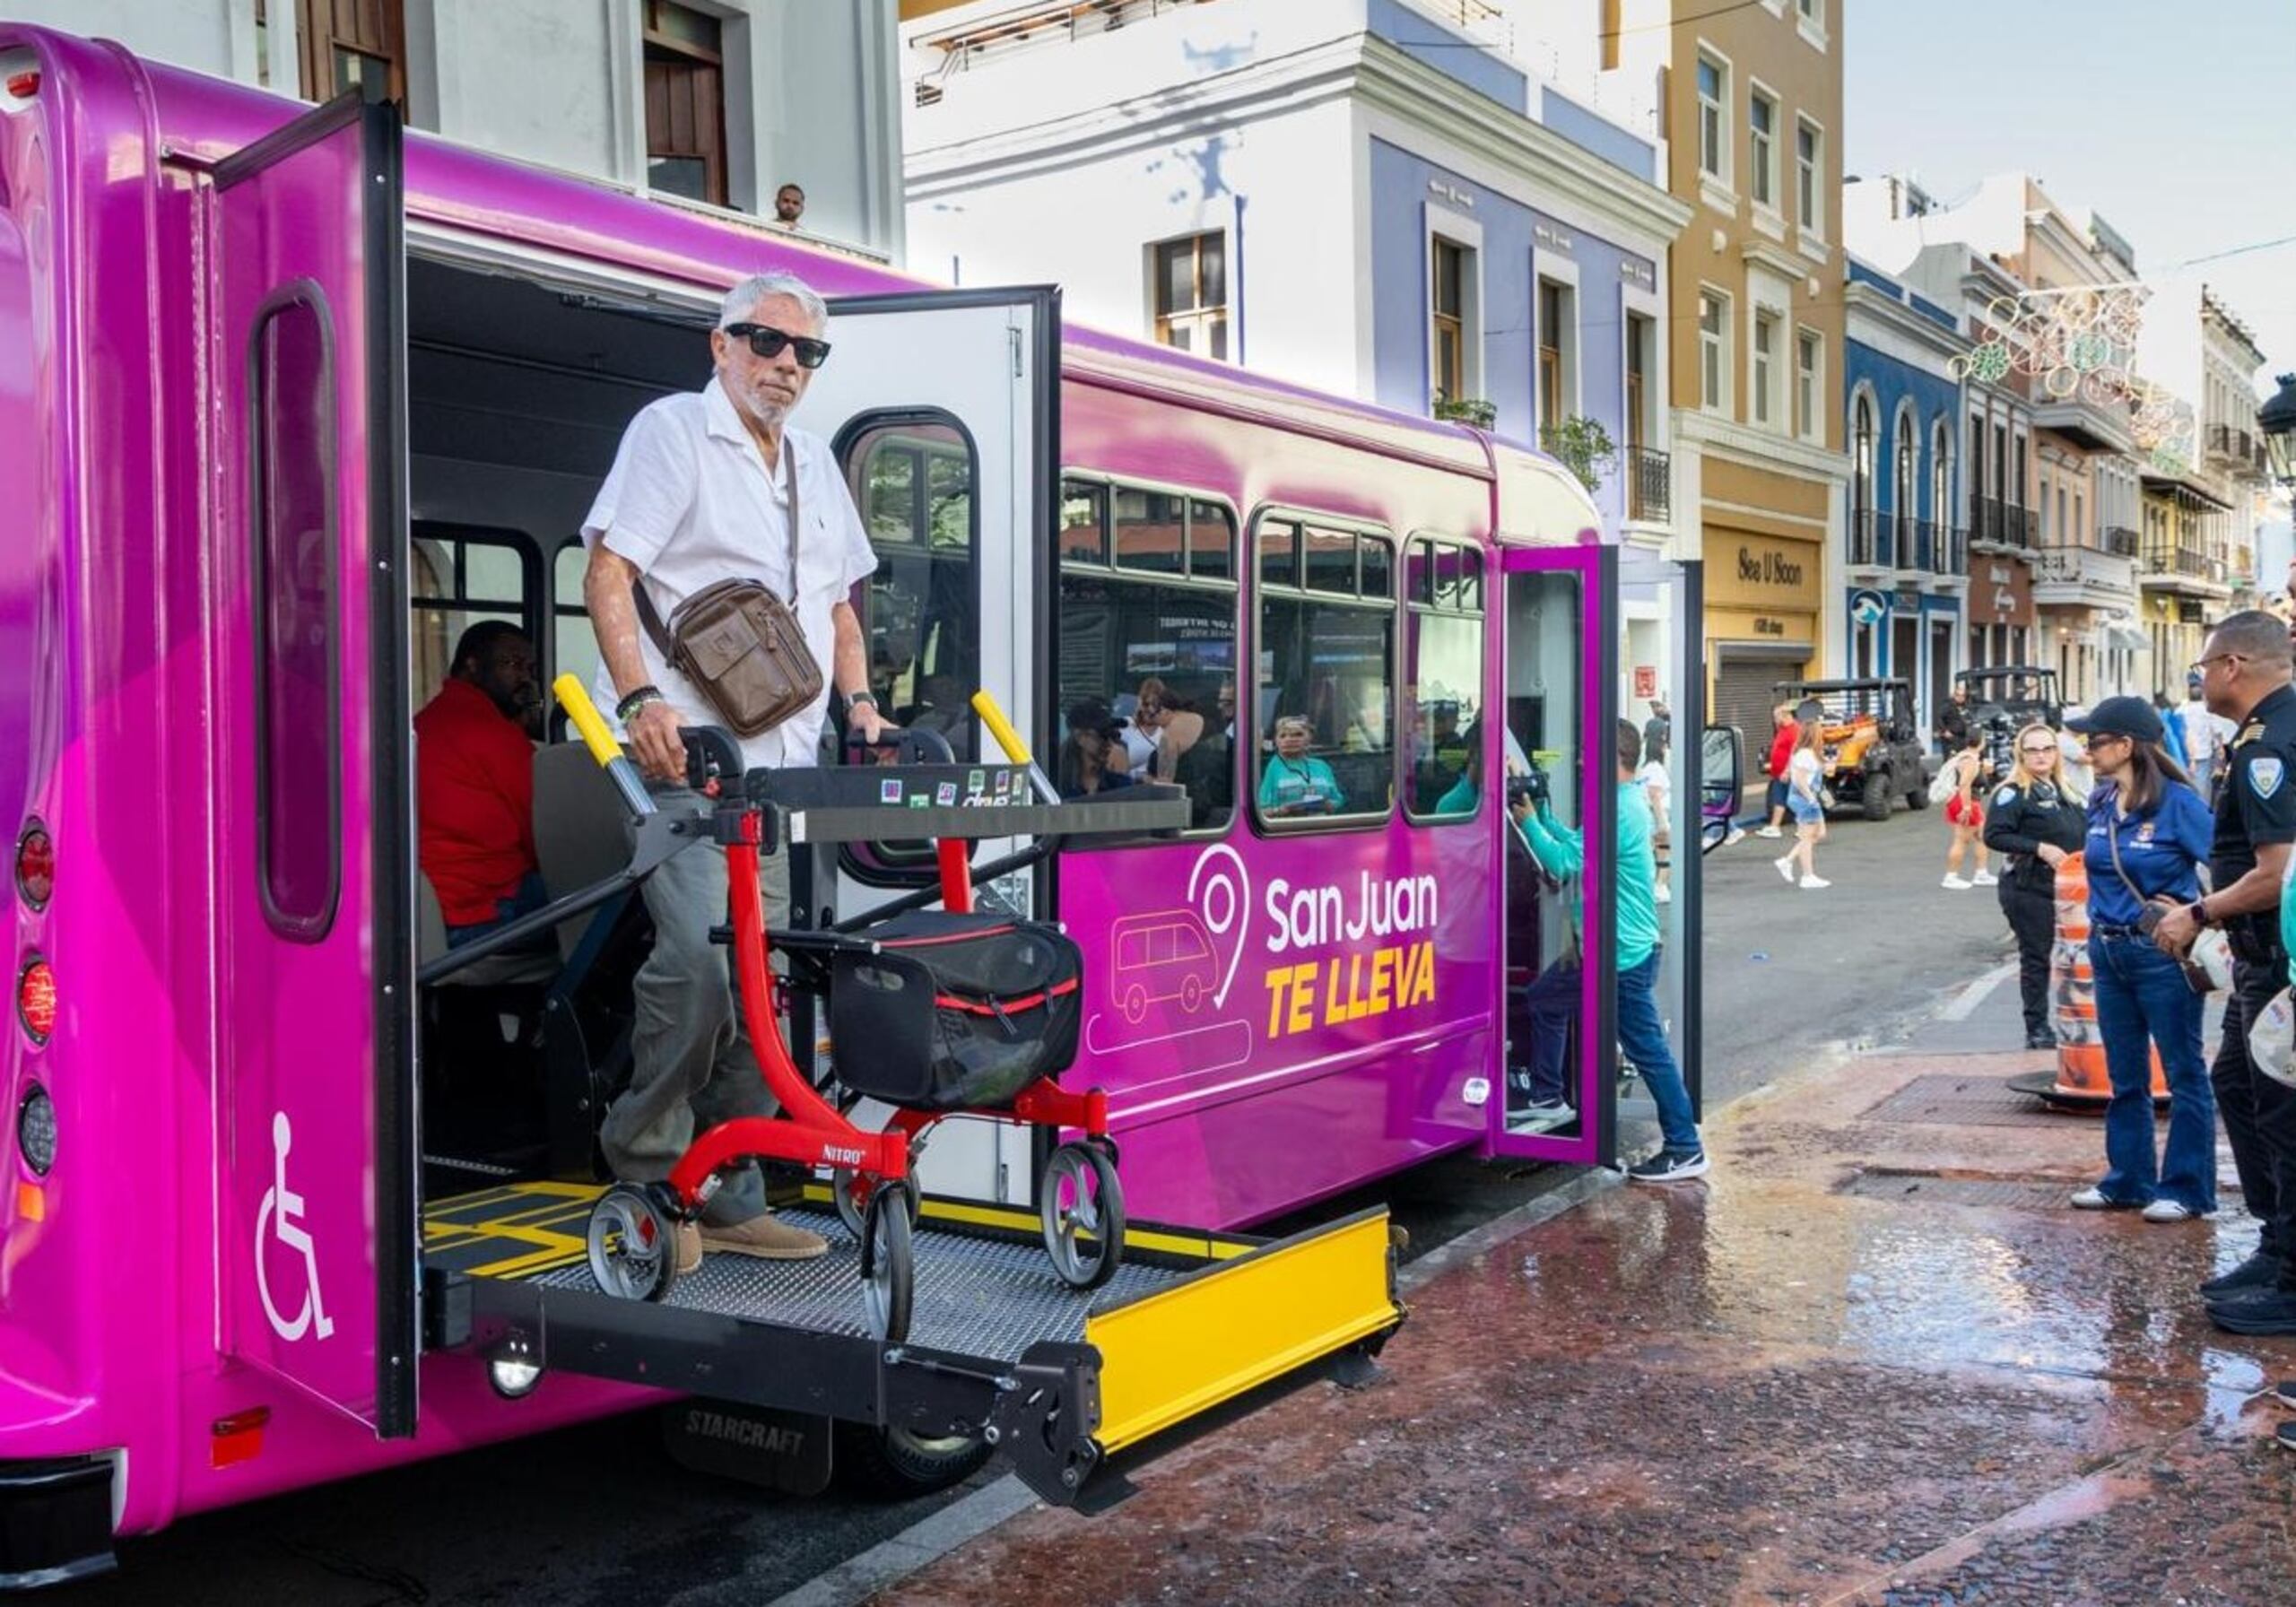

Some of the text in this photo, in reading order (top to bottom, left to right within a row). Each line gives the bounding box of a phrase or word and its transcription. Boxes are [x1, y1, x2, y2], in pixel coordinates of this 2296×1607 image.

[1739, 547, 1801, 586] See U Soon
[1265, 870, 1438, 952] San Juan
[1265, 942, 1436, 1039] TE LLEVA
[685, 1410, 804, 1457] STARCRAFT
